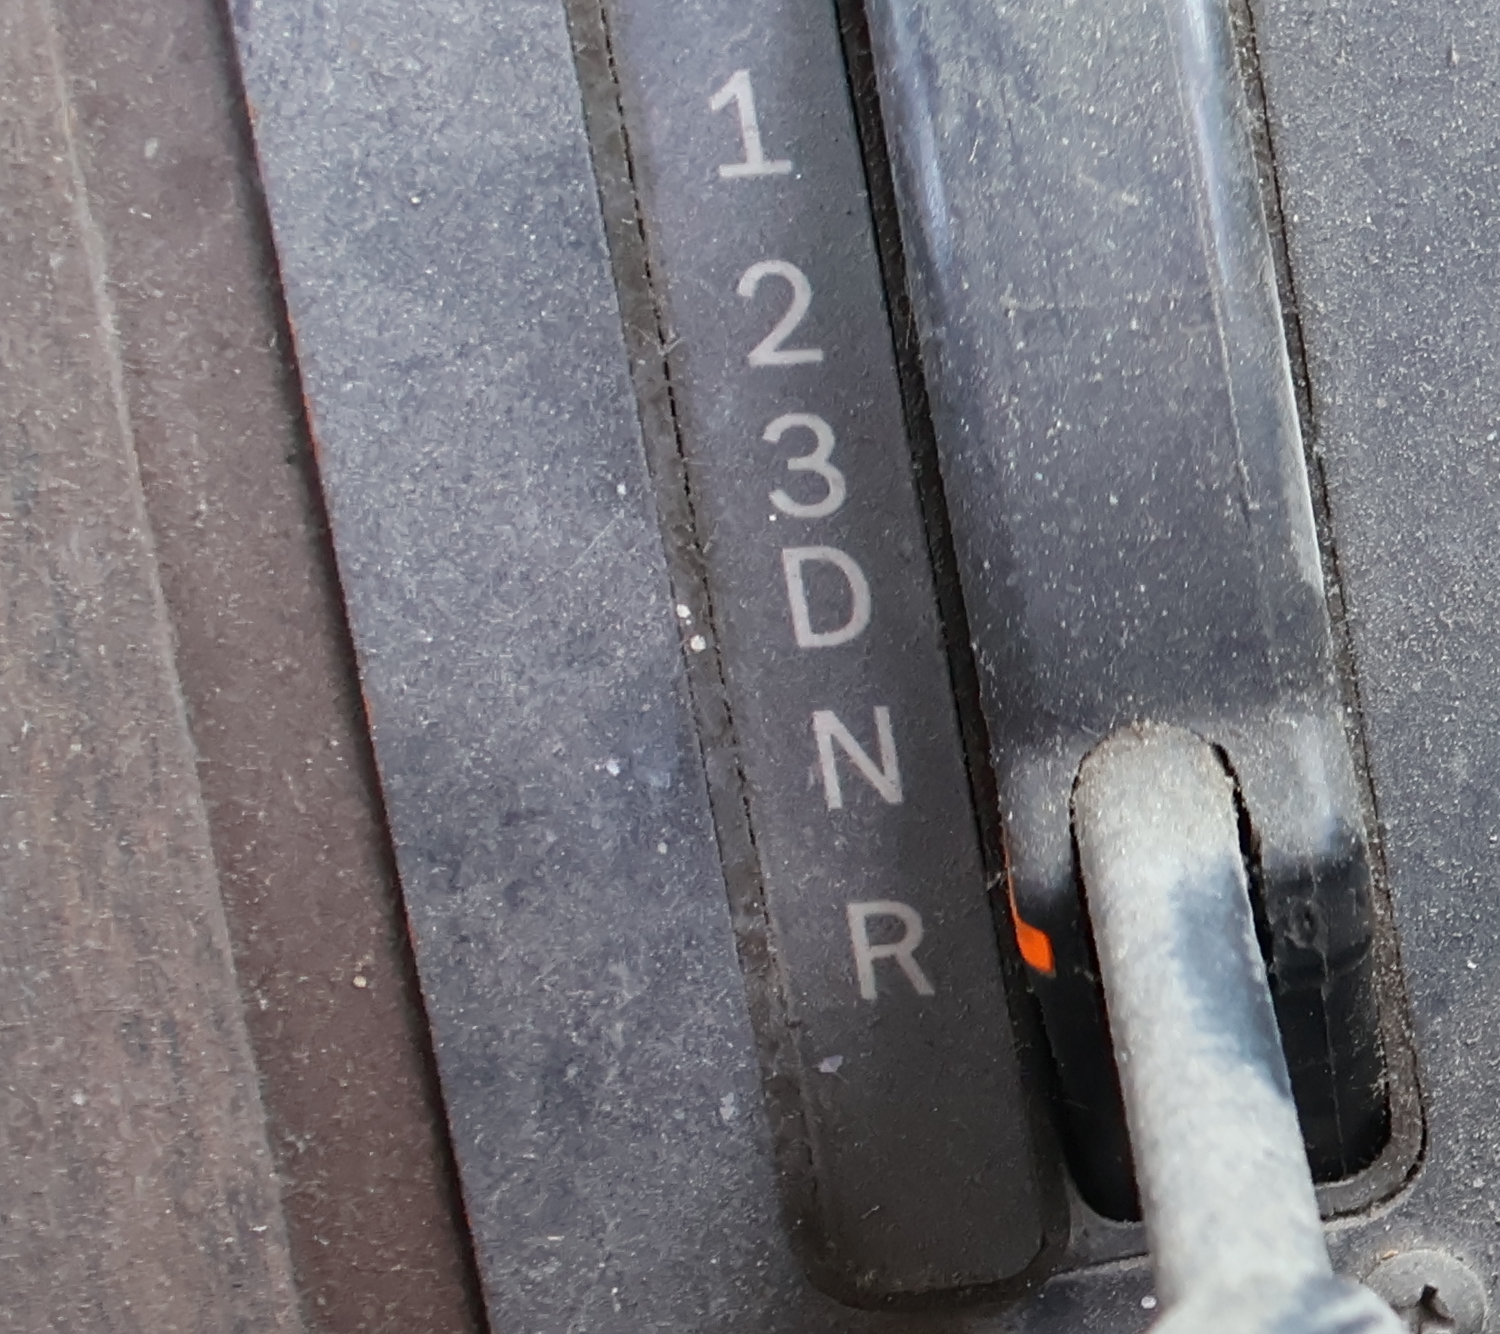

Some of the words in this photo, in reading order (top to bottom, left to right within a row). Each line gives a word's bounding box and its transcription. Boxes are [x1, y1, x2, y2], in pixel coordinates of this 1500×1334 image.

[708, 69, 793, 178] 1
[736, 261, 824, 365] 2
[761, 412, 848, 520] 3
[781, 547, 872, 649] D
[812, 703, 904, 810] N
[846, 900, 937, 1001] R
